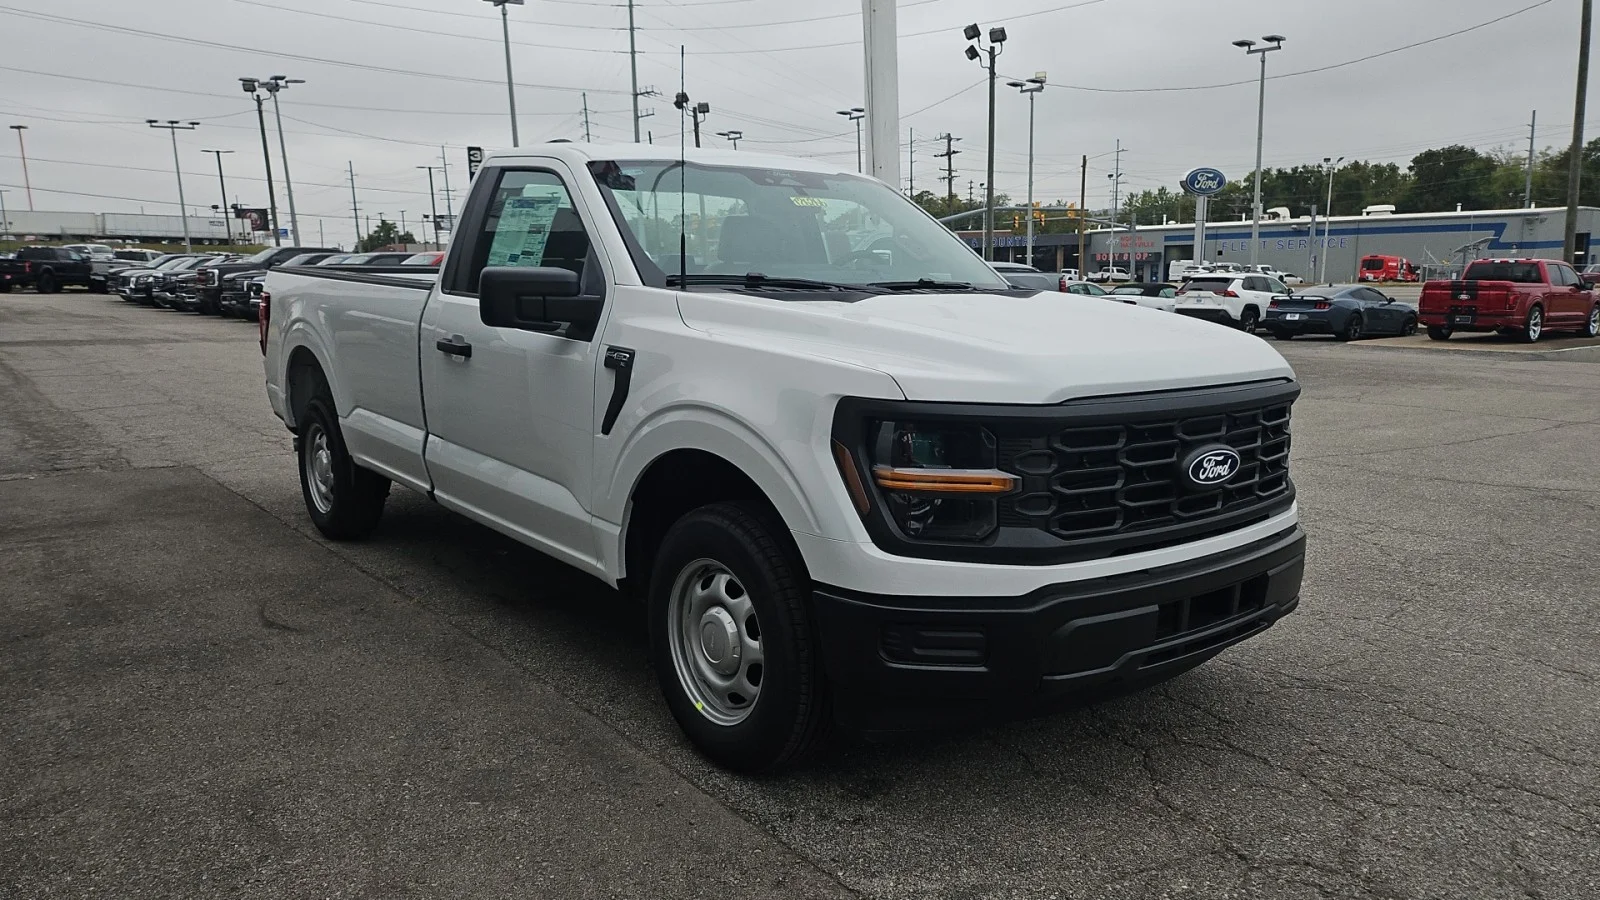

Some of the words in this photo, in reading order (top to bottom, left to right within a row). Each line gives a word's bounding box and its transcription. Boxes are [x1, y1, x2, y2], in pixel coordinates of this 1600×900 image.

[1194, 172, 1219, 190] Ford
[1222, 240, 1267, 251] FLET
[1122, 252, 1148, 260] SOP
[1199, 455, 1232, 480] Ford
